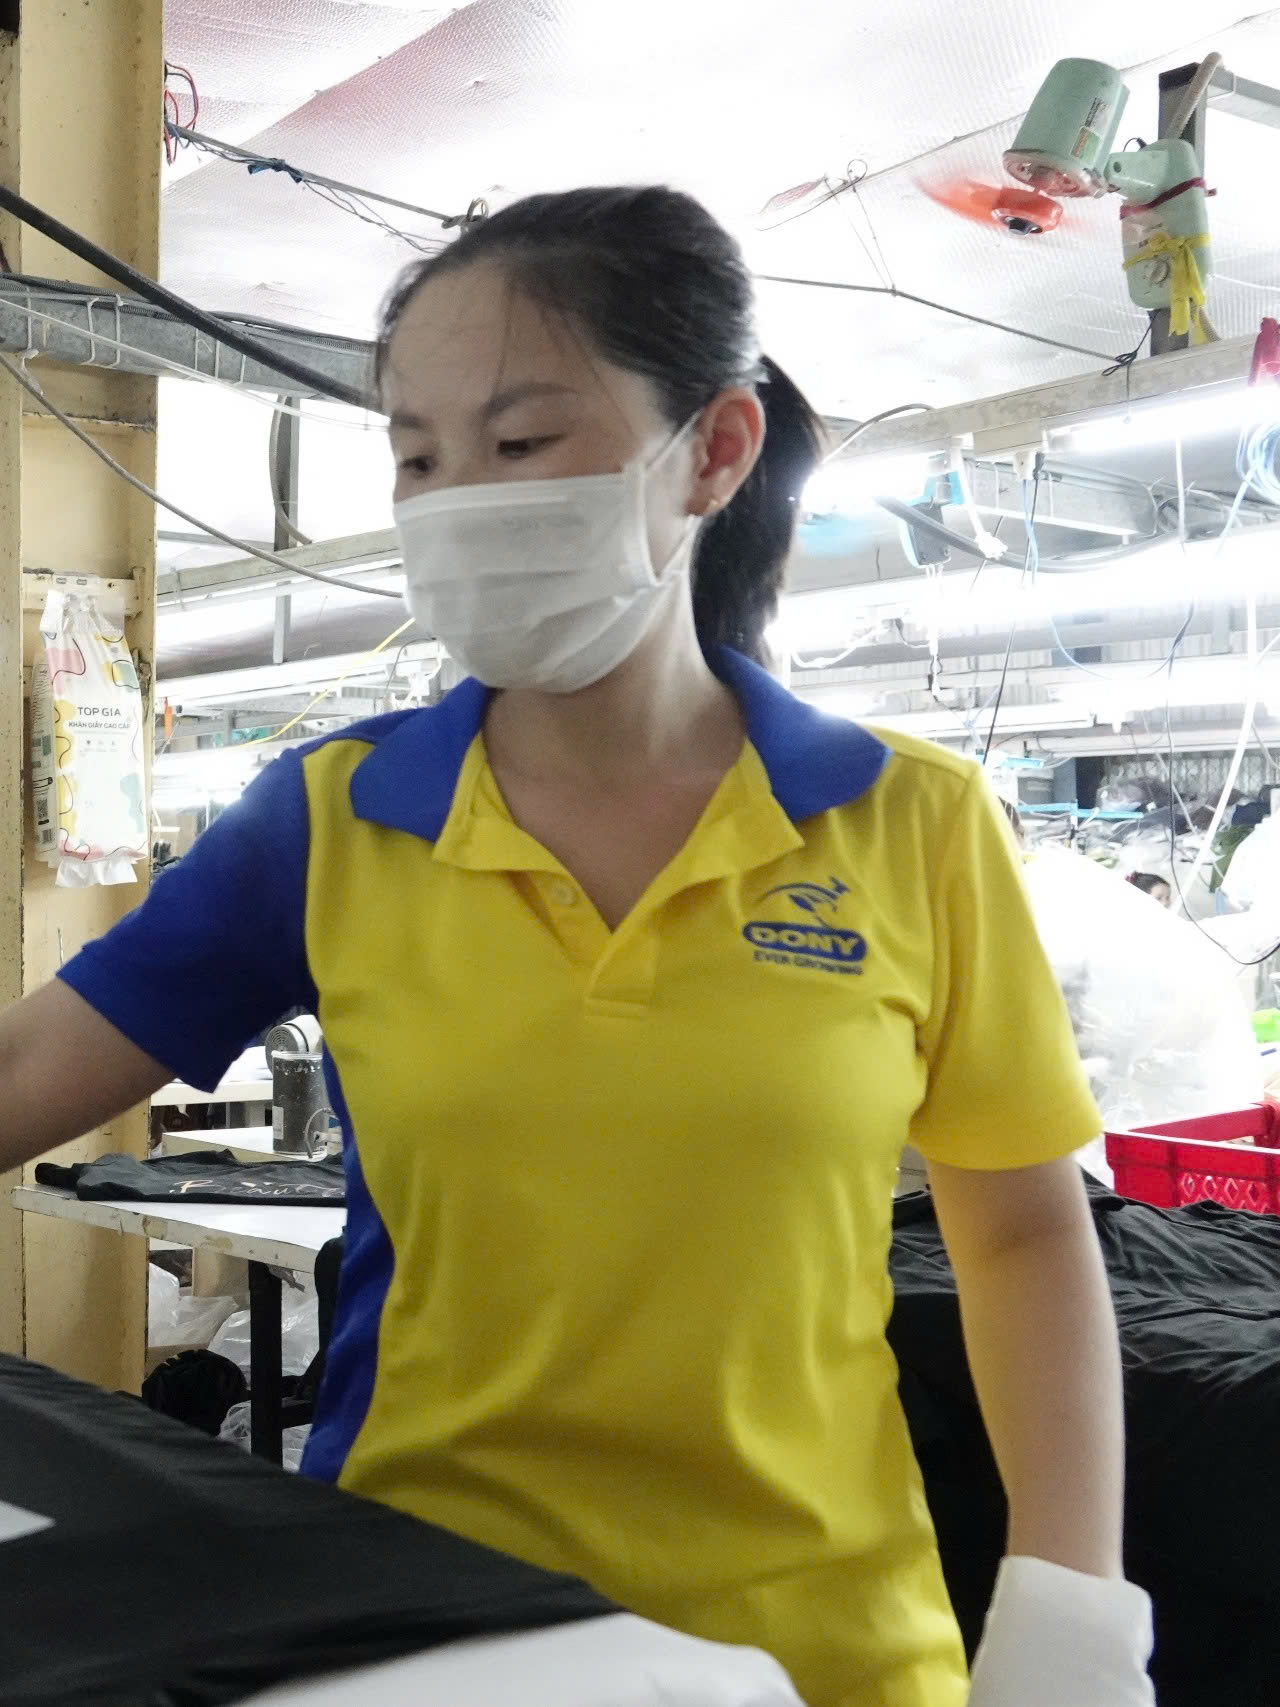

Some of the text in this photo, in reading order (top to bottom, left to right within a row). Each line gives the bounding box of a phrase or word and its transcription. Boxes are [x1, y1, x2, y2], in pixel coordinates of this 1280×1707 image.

[77, 706, 121, 716] TOP GIA
[750, 924, 860, 956] DONY
